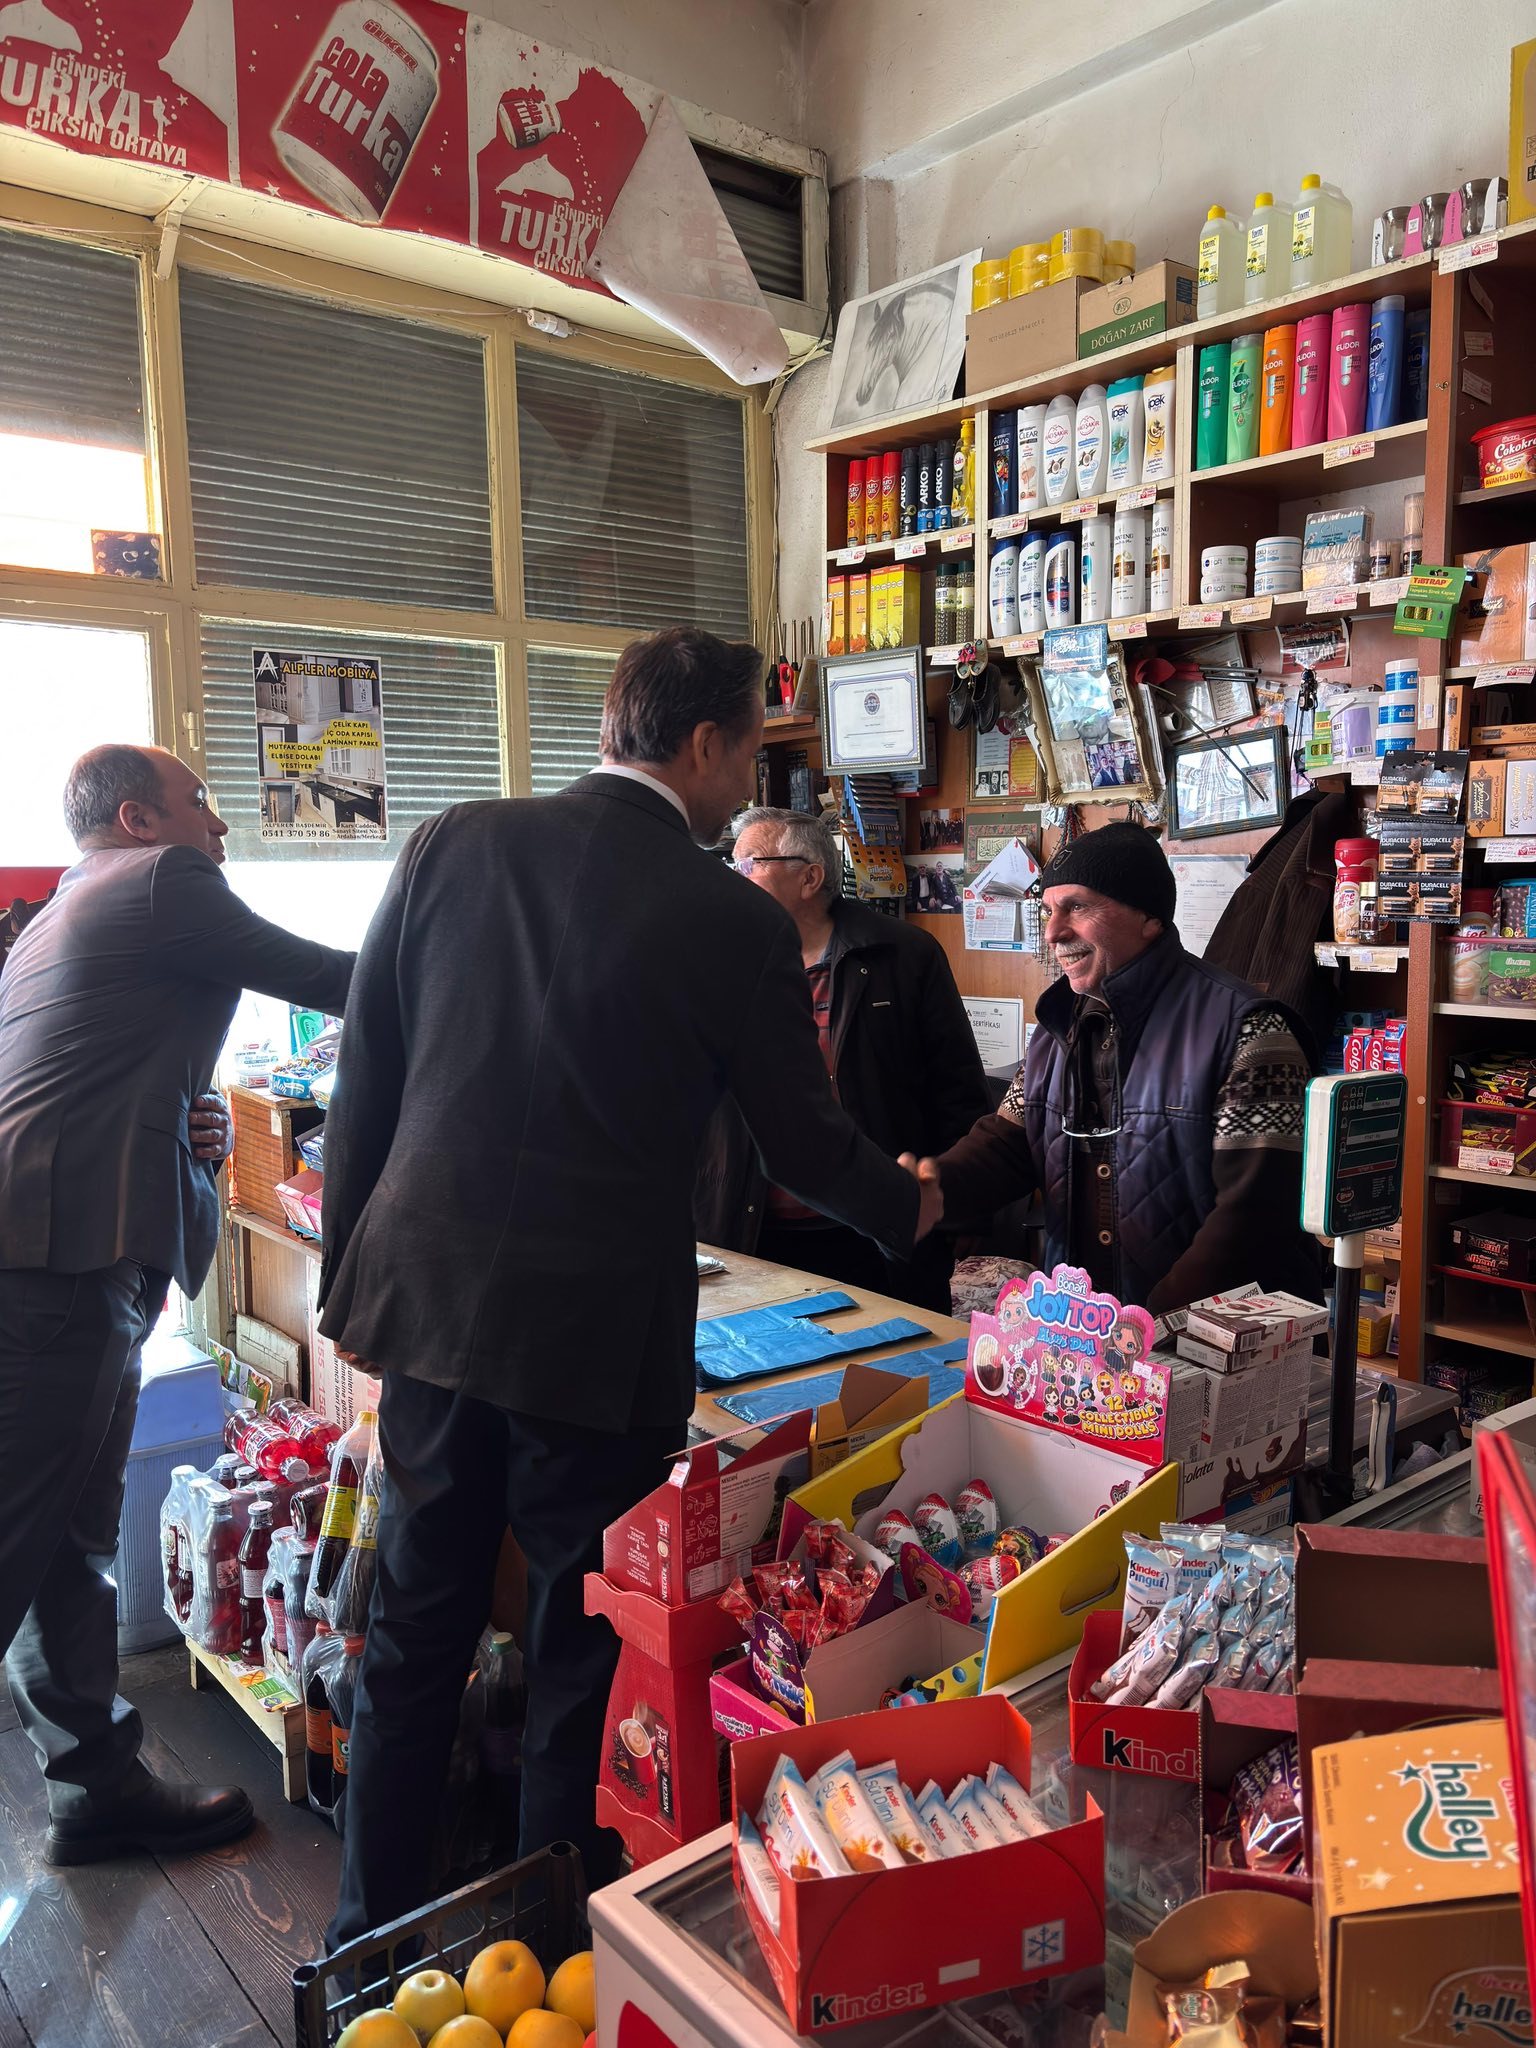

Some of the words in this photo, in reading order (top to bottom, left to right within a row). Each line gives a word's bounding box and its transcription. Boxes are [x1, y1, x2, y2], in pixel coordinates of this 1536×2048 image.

[51, 51, 126, 90] İÇİNDEKİ
[0, 55, 141, 138] URKA
[303, 66, 410, 178] Turka
[26, 107, 103, 145] ÇIKSIN
[110, 129, 187, 168] ORTAYA
[500, 201, 601, 263] TURK
[1091, 327, 1127, 350] DOĞAN
[1129, 316, 1156, 335] ZARF
[1111, 404, 1129, 420] ipek
[1148, 394, 1165, 410] ipek
[993, 437, 1009, 447] CLEAR
[1019, 430, 1039, 439] CLEAR
[919, 470, 929, 505] ARKO
[935, 467, 943, 502] ARKO
[1485, 474, 1509, 486] AVANTAJ
[1510, 471, 1523, 480] BOY
[282, 662, 325, 677] ALPLER
[326, 664, 378, 680] MOBİLYA
[332, 720, 352, 728] ÇELİK
[359, 740, 379, 748] PARKE
[280, 761, 313, 770] VESTİYER
[262, 829, 284, 838] 0541
[287, 830, 304, 838] 370
[306, 830, 317, 838] 59
[319, 830, 330, 838] 86
[1350, 1038, 1361, 1073] Colg
[1370, 1040, 1382, 1071] Colg
[1057, 1273, 1087, 1295] Bonart
[1105, 1395, 1123, 1412] 12
[1204, 1377, 1213, 1418] Biscolata
[1079, 1405, 1158, 1426] COLLECTIBLE
[1082, 1422, 1116, 1438] MINI
[1116, 1421, 1159, 1440] DOLLS
[1182, 1559, 1207, 1568] inder
[1102, 1729, 1200, 1779] Kind
[1429, 1761, 1499, 1861] halley
[1452, 1990, 1534, 2024] halle
